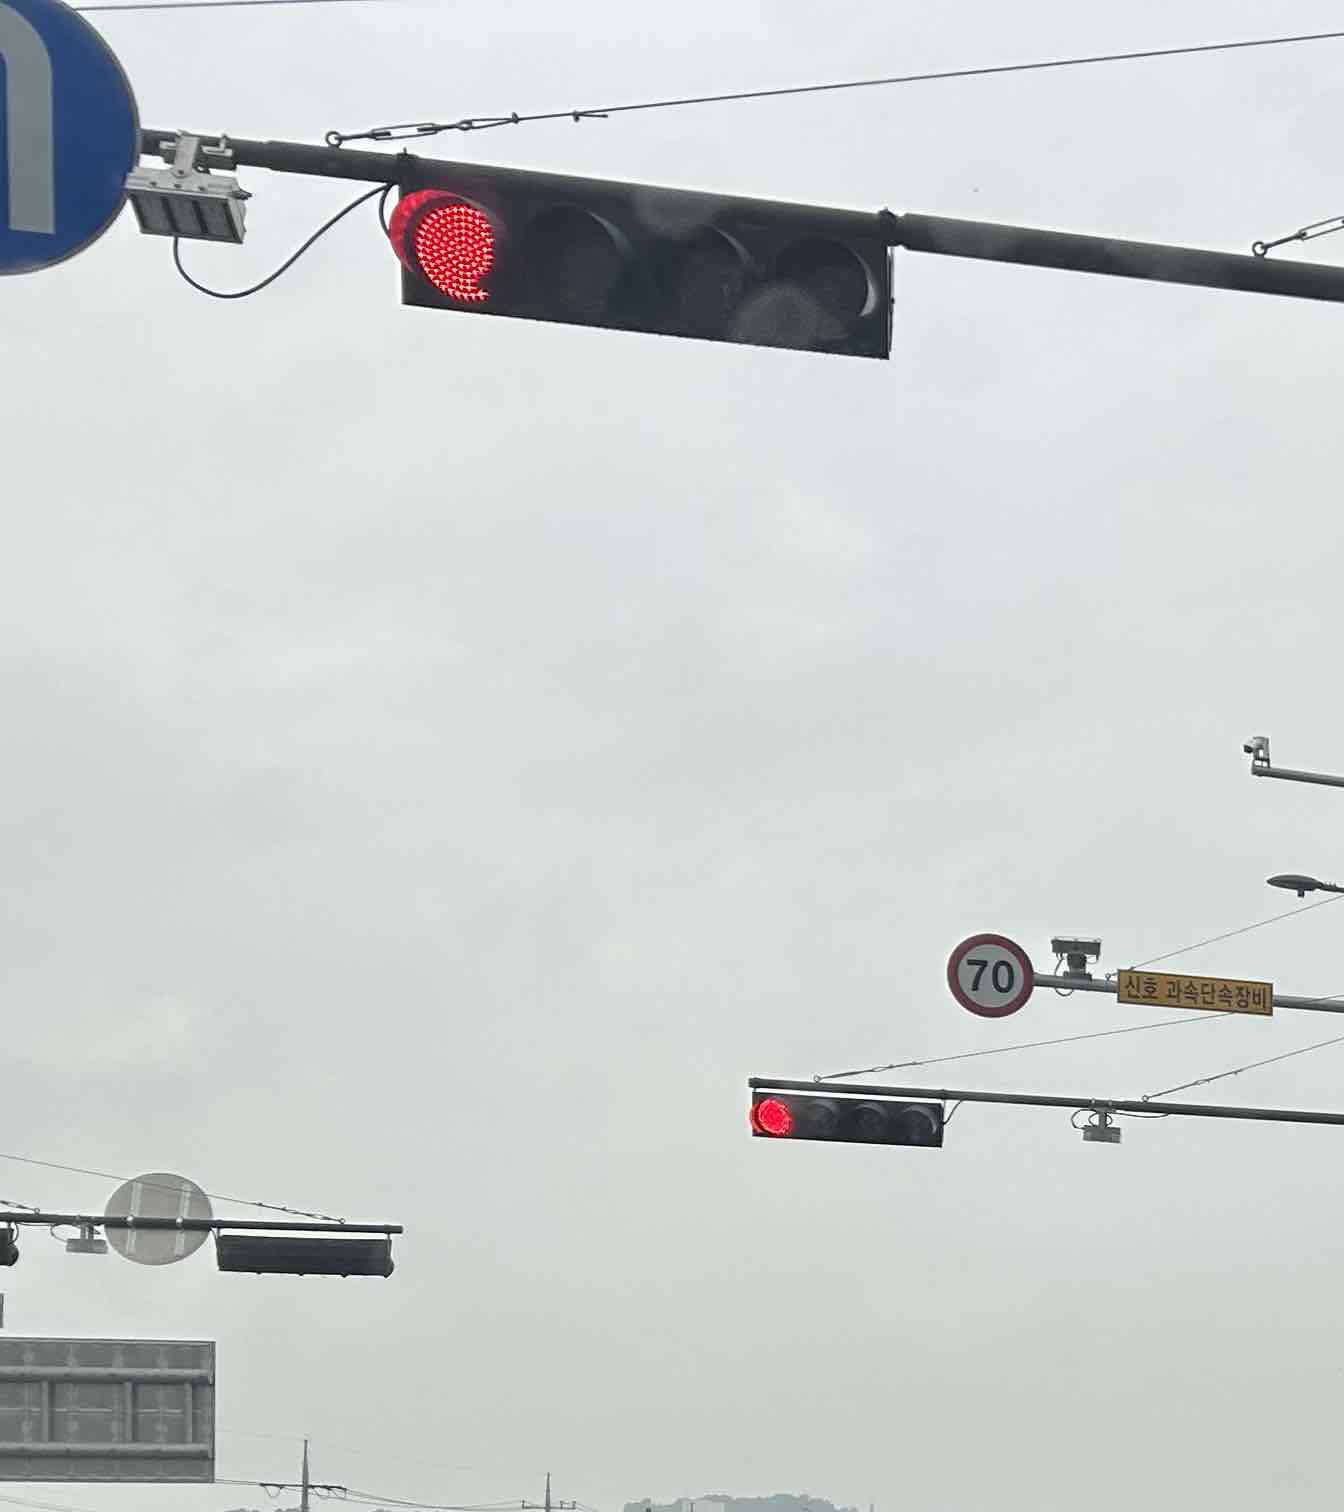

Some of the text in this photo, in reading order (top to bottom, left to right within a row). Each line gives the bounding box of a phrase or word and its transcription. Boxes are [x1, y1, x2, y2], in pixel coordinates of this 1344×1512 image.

[967, 959, 1014, 993] 70
[1125, 975, 1266, 1009] 신호 과속단속장비
